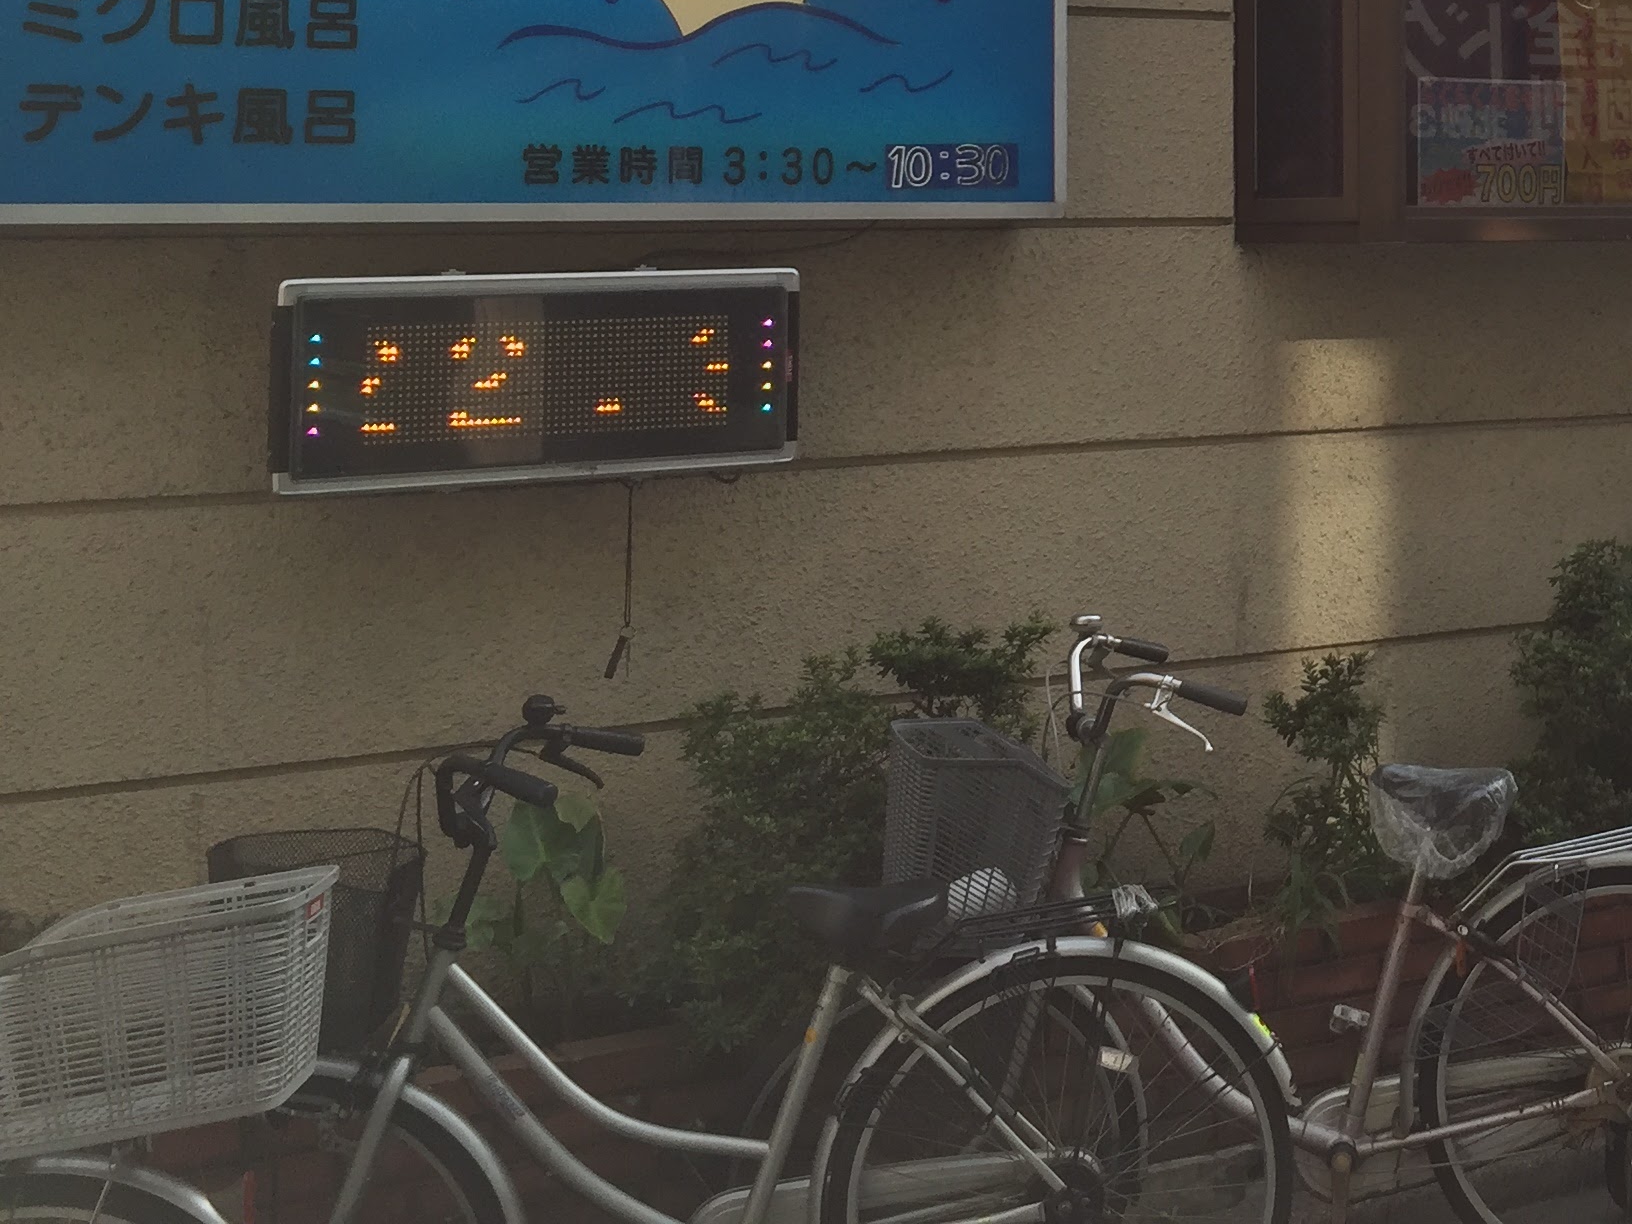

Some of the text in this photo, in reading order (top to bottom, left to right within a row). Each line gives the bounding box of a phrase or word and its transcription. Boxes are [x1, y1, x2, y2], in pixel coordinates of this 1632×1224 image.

[19, 81, 357, 146] デンキ風呂
[522, 144, 706, 186] 営業時間
[1475, 162, 1563, 205] 700円
